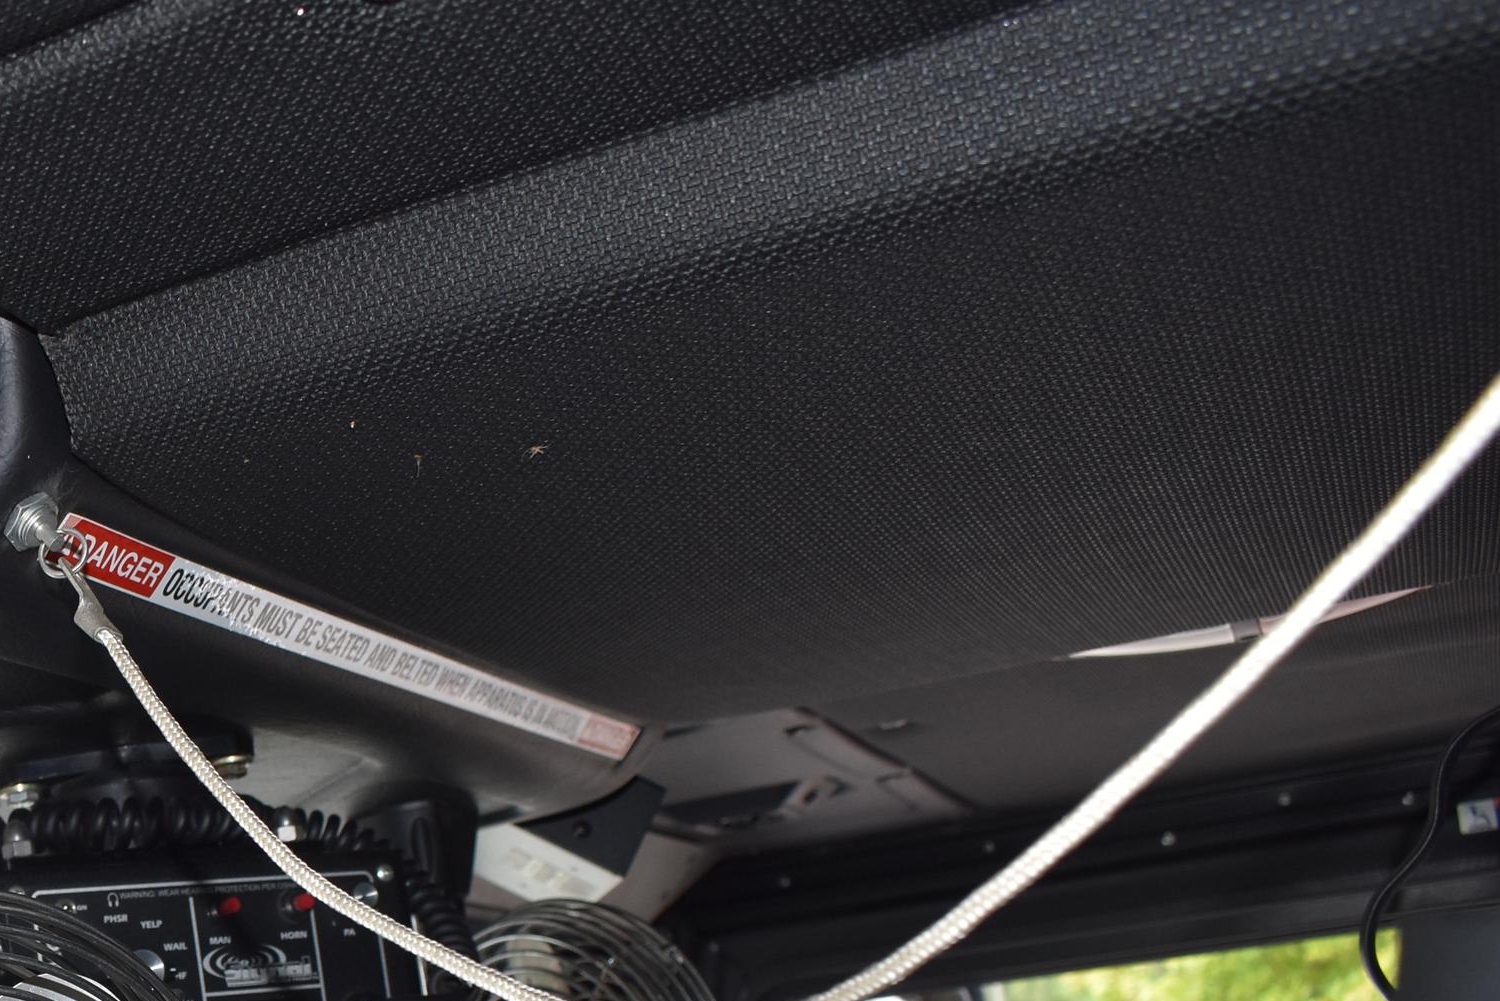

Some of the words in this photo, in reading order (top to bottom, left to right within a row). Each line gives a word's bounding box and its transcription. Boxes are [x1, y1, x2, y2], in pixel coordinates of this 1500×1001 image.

[73, 534, 165, 588] DANGER
[162, 568, 261, 623] OCCUPANTS
[254, 602, 303, 639] MUST
[294, 616, 323, 647] BE
[315, 624, 372, 662] SEATED
[364, 643, 398, 672] AND
[391, 653, 440, 686] BELTED
[140, 920, 163, 929] YELP
[280, 931, 308, 940] HORN
[209, 936, 231, 945] MAN
[163, 943, 187, 951] WAIL
